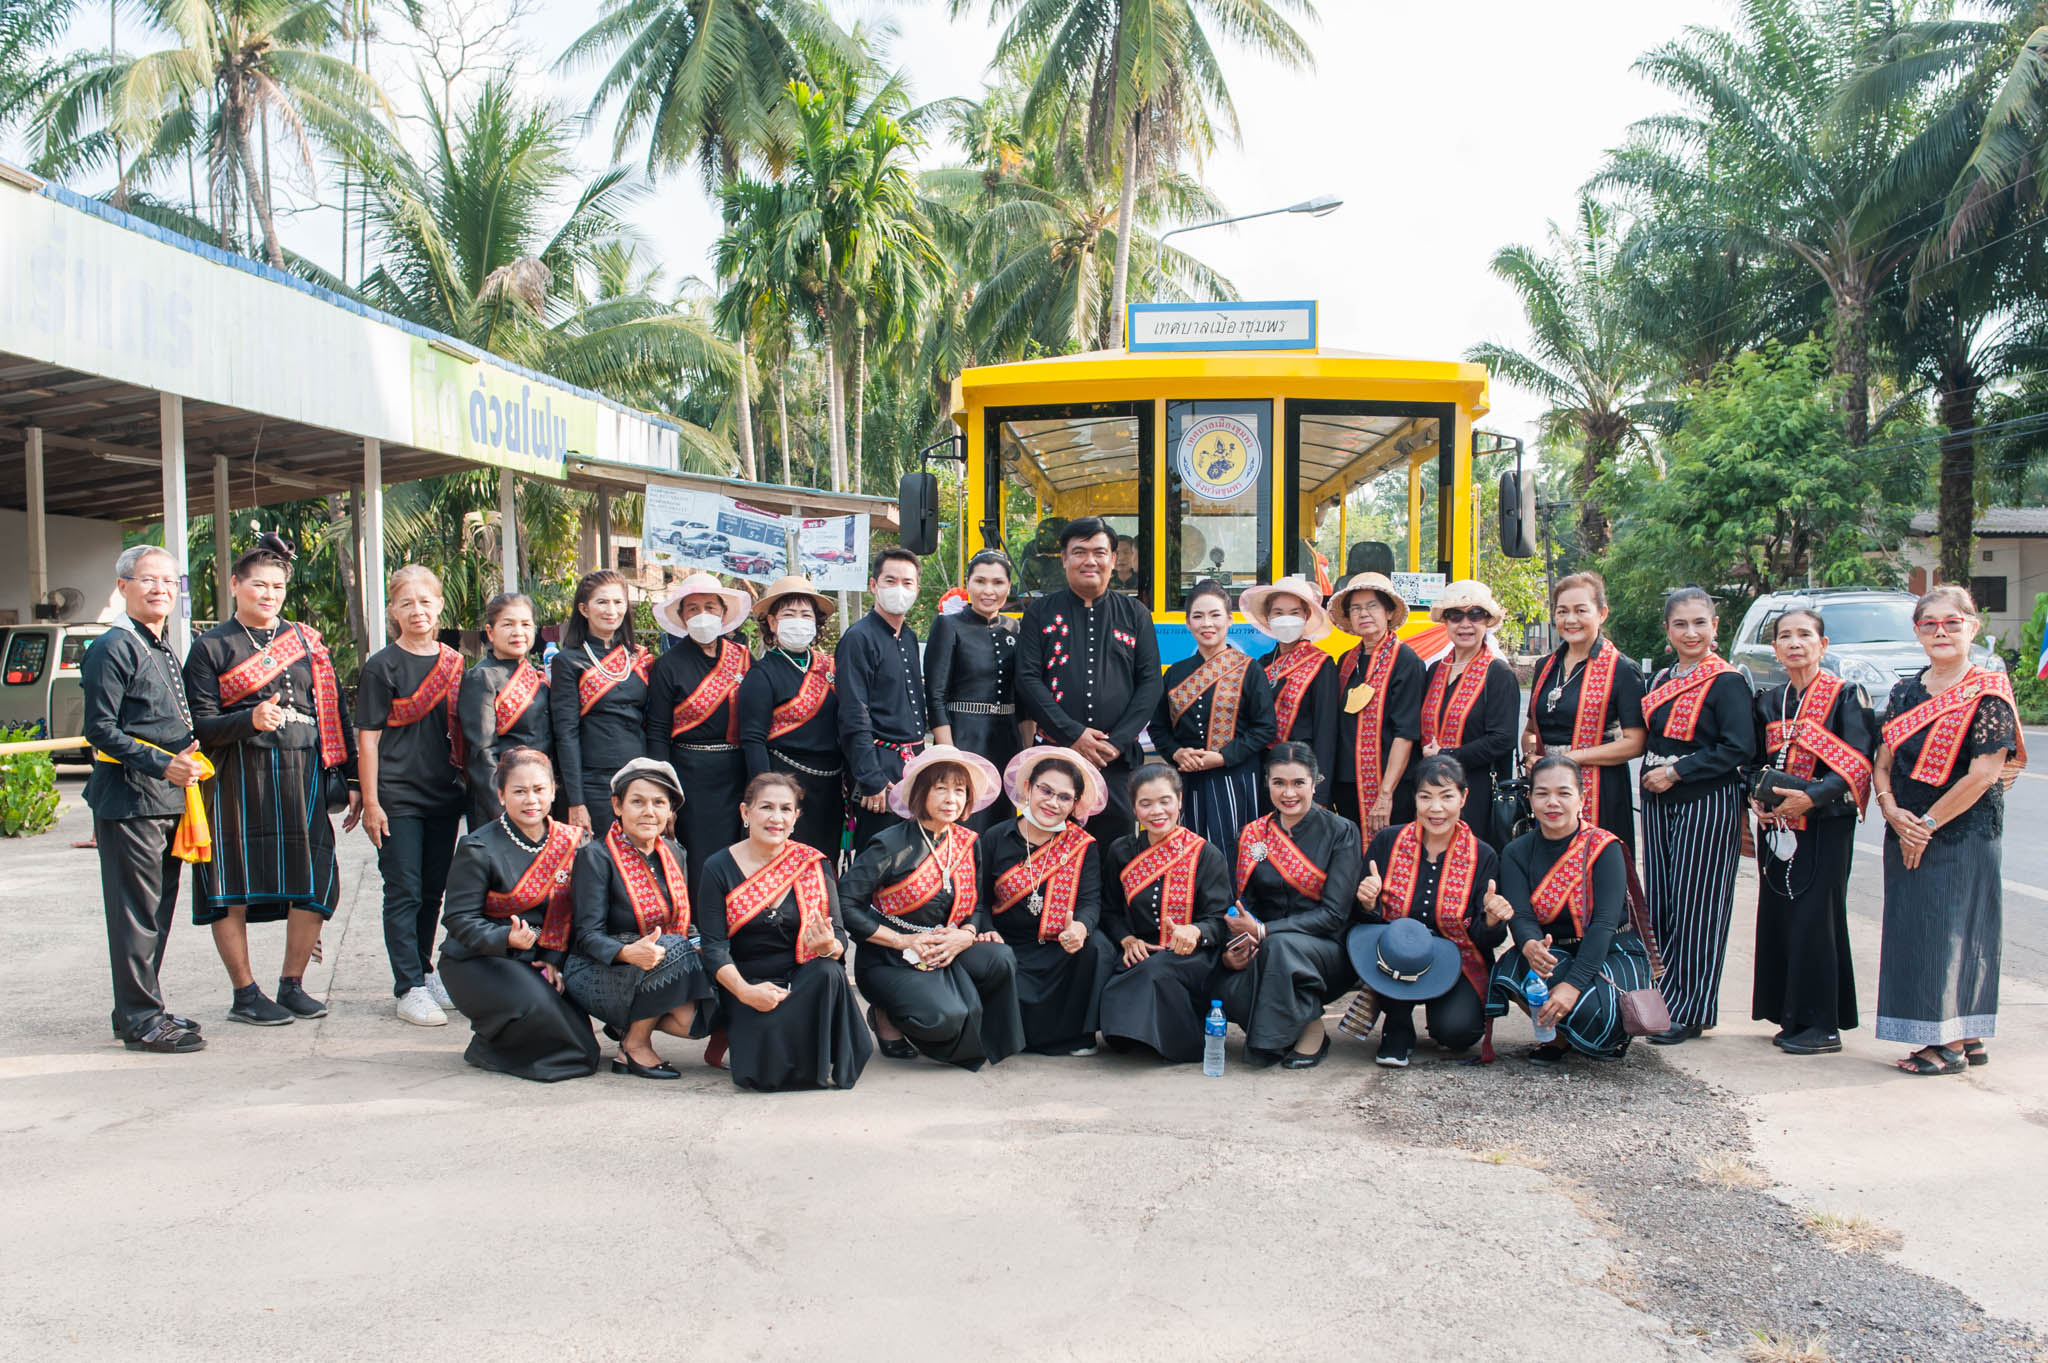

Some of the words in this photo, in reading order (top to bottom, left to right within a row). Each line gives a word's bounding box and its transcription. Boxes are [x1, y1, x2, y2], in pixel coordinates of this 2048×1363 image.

[1154, 312, 1288, 339] เทศบาลเมืองชุมพร
